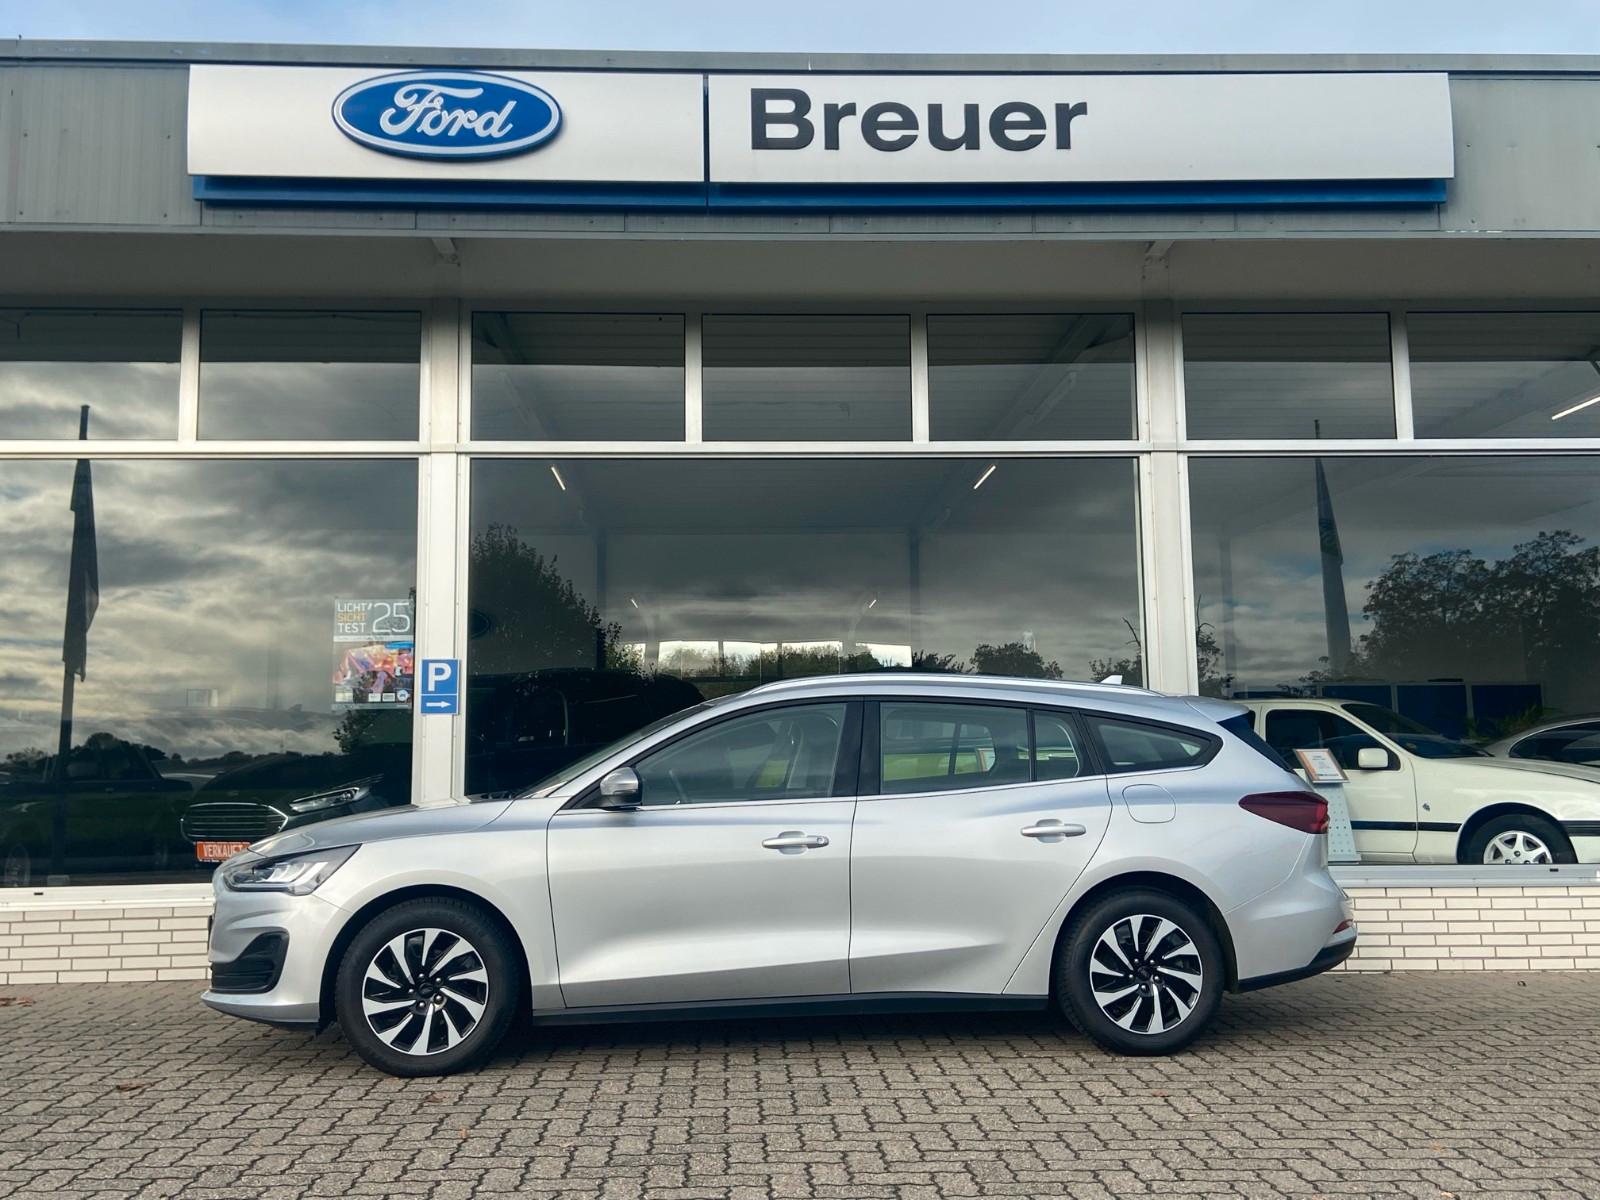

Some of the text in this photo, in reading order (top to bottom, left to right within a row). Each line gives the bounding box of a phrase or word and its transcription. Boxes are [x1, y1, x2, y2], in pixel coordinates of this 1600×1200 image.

[379, 83, 517, 138] Ford
[750, 88, 1088, 152] Breuer
[337, 602, 367, 612] LICHT
[337, 622, 366, 633] TEST
[427, 662, 452, 692] P
